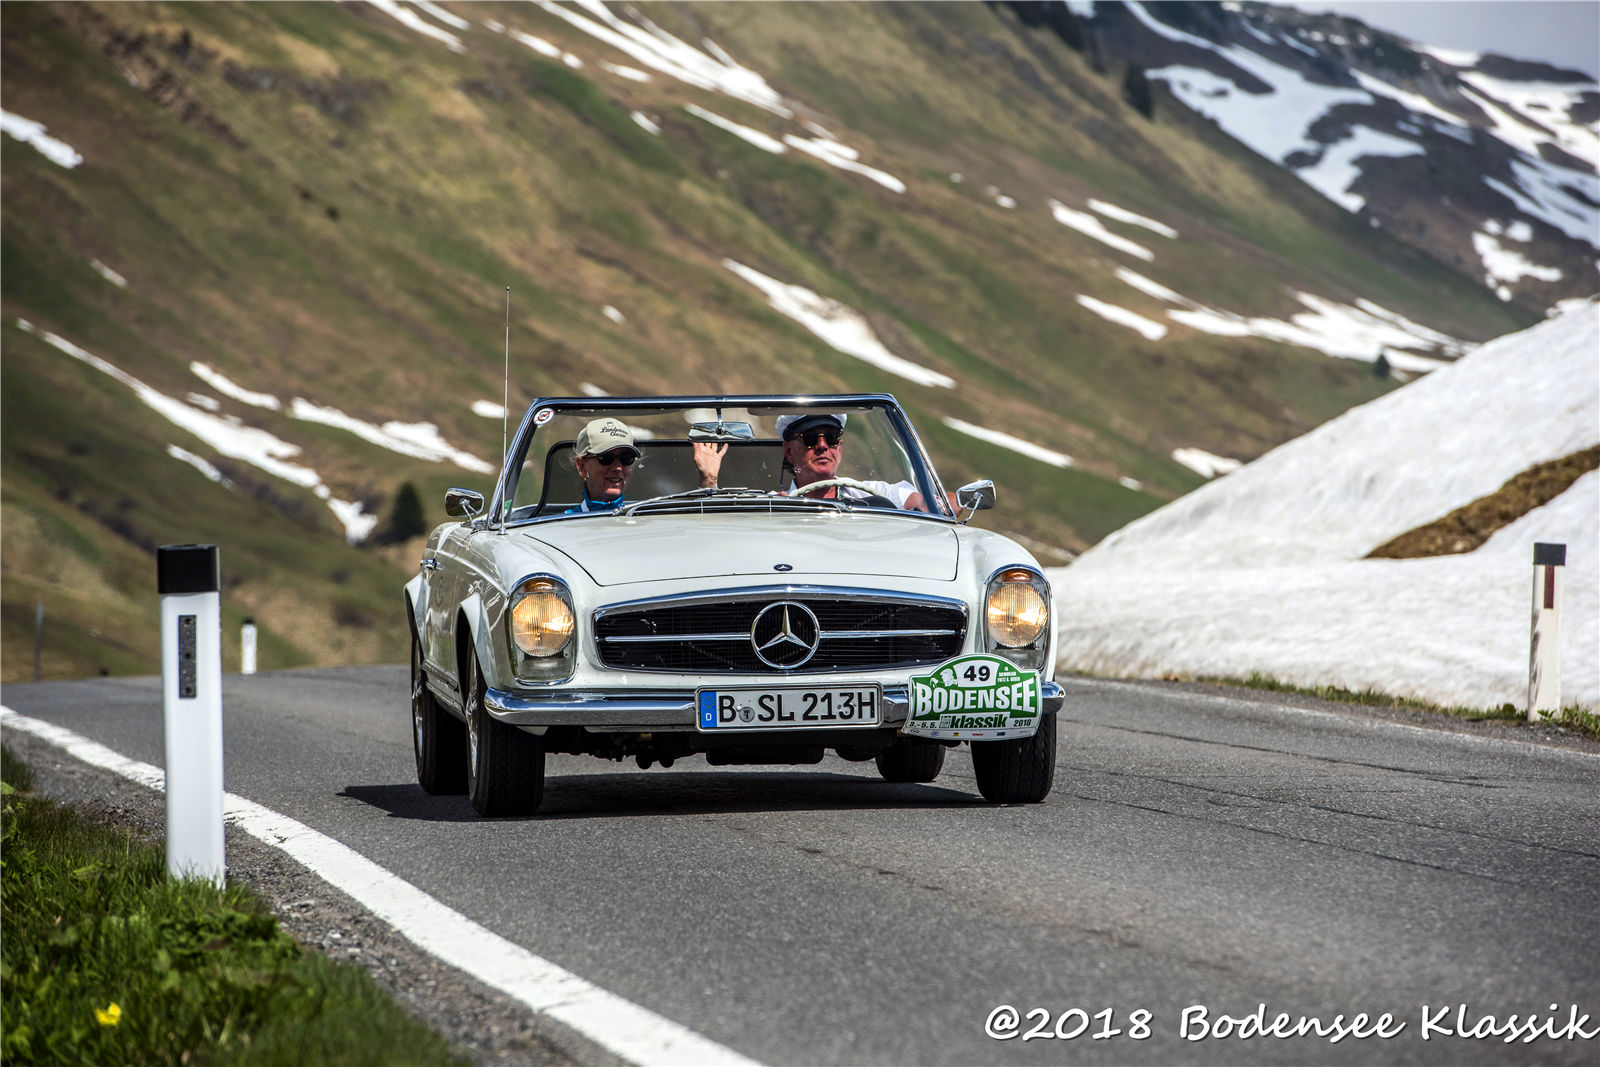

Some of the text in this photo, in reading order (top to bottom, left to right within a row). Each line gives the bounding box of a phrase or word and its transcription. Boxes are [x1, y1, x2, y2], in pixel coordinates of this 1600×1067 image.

[963, 665, 991, 682] 49
[915, 678, 1035, 717] BODENSEE
[718, 691, 875, 722] B SL 213H
[704, 712, 712, 721] D
[950, 714, 1008, 728] klassik
[1013, 719, 1032, 727] 2018
